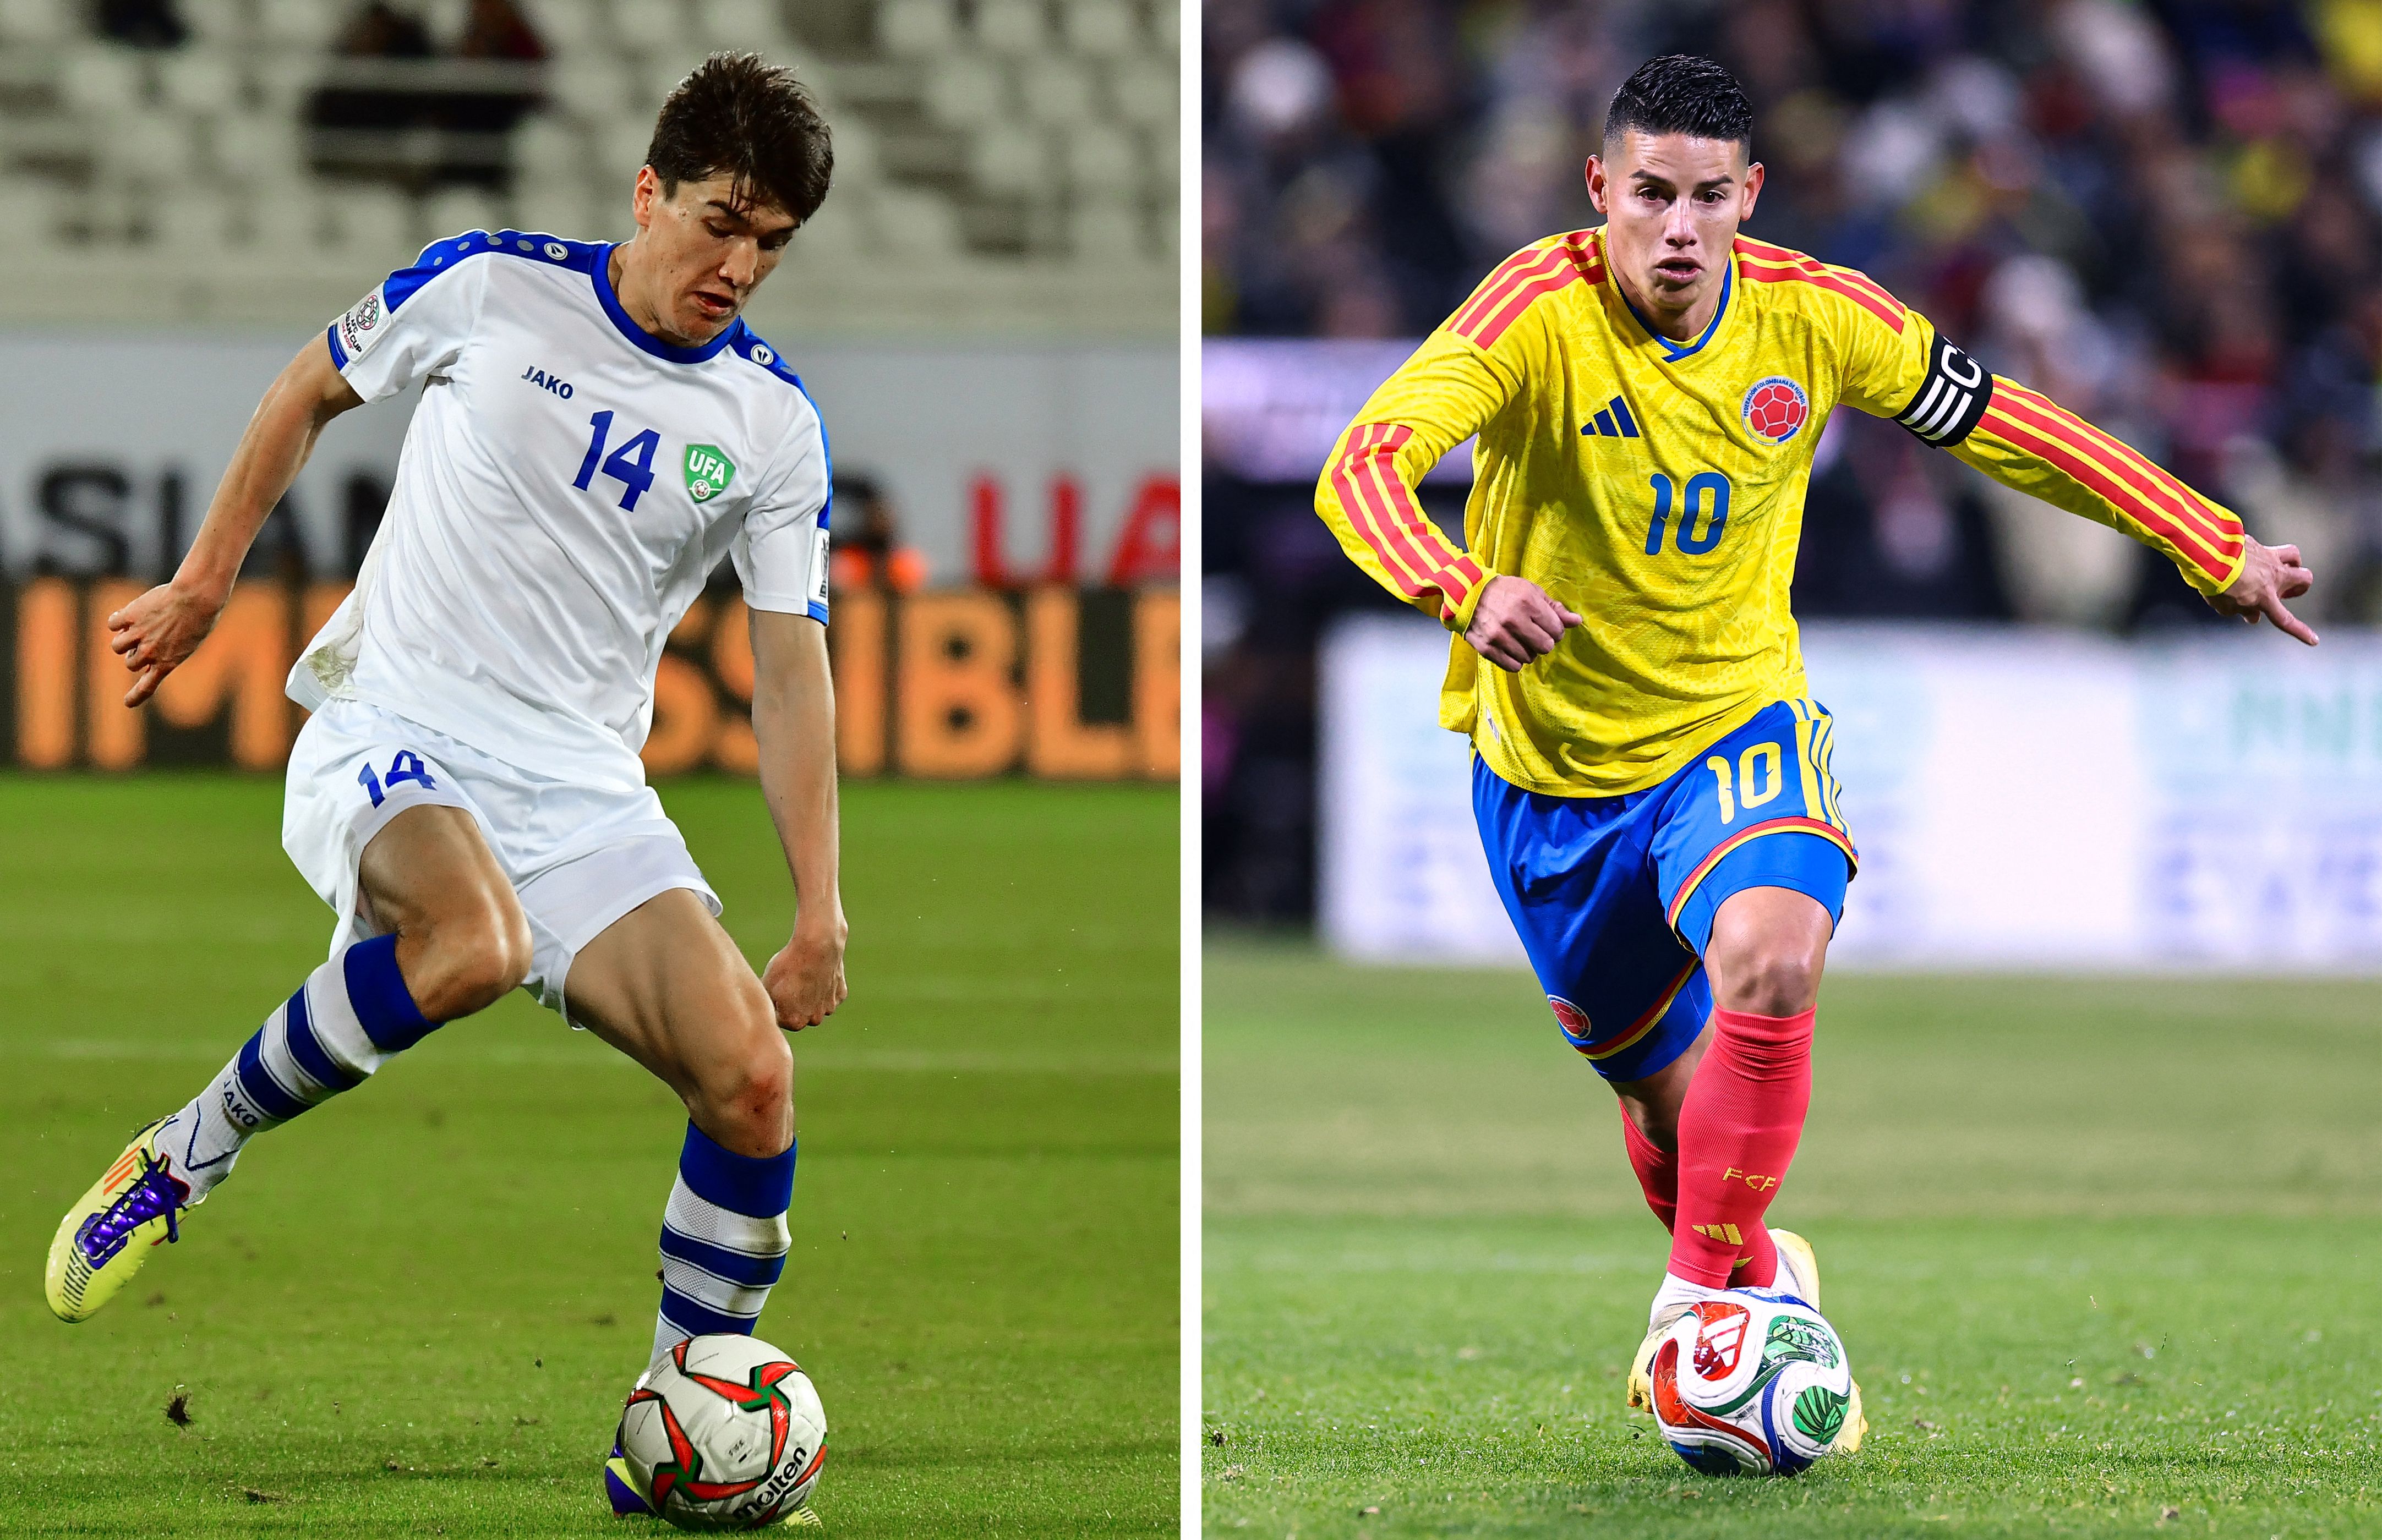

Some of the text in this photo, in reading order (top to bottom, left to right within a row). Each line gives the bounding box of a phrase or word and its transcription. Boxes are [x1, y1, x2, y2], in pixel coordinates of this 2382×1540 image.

[350, 334, 362, 353] CUP
[521, 365, 573, 400] JAKO
[1757, 378, 1789, 389] COLOMBIANA
[572, 410, 661, 513] 14
[689, 450, 725, 485] UFA
[1645, 472, 1730, 556] 10
[358, 749, 438, 809] 14
[1706, 742, 1782, 825] 10
[1722, 1166, 1777, 1192] FCF
[1779, 1322, 1831, 1343] TRIONDA
[733, 1446, 807, 1517] molten
